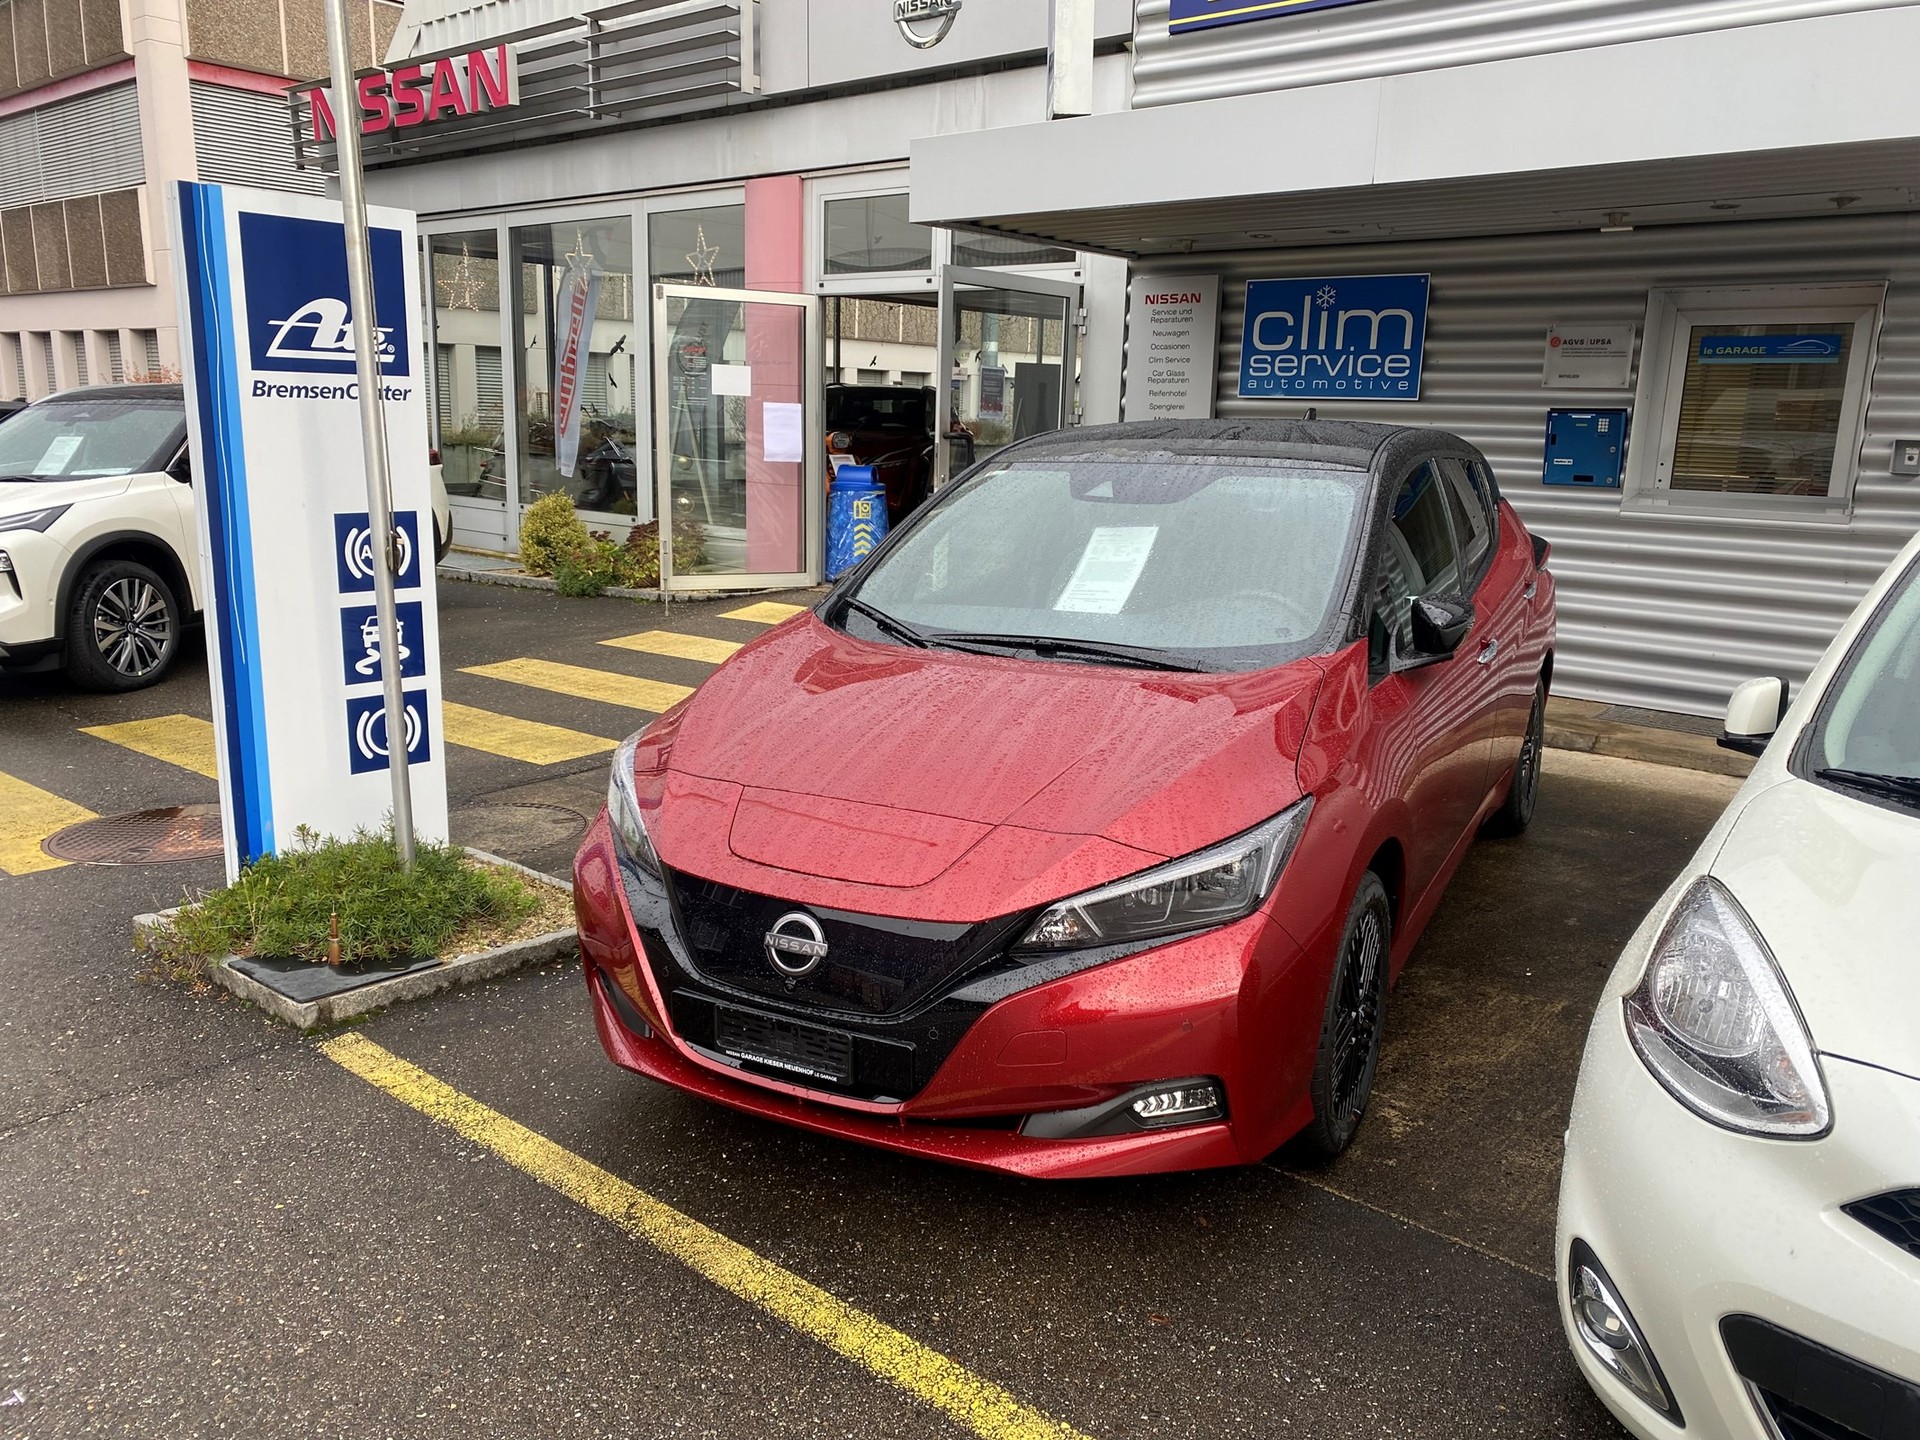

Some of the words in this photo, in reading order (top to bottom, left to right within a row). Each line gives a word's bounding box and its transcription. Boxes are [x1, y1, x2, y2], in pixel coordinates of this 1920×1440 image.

[310, 43, 510, 142] NSSAN
[1144, 293, 1201, 305] NISSAN
[1179, 308, 1193, 316] und
[1150, 316, 1194, 324] Reparaturen
[1252, 288, 1414, 351] clim
[1152, 330, 1190, 338] Neuwagen
[1562, 338, 1585, 346] AGVS
[1589, 338, 1612, 346] UPSA
[1150, 343, 1191, 351] Occasionen
[1703, 347, 1713, 355] le
[1715, 346, 1767, 355] GARAGE
[1148, 356, 1164, 364] Clim
[1165, 356, 1191, 364] Service
[1249, 346, 1411, 377] service
[1166, 369, 1186, 377] Glass
[1147, 376, 1190, 384] Reparaturen
[1247, 377, 1409, 390] automotive
[252, 380, 412, 402] BremsenCter
[1149, 389, 1187, 397] Reifenhotel
[1149, 402, 1185, 411] Spenglerei
[765, 934, 826, 957] NISSAN
[725, 1049, 741, 1057] NISSAN
[741, 1052, 763, 1064] GARAGE
[763, 1058, 784, 1069] KIESER
[784, 1063, 814, 1077] NEUENHOF
[820, 1073, 838, 1082] GARAGE
